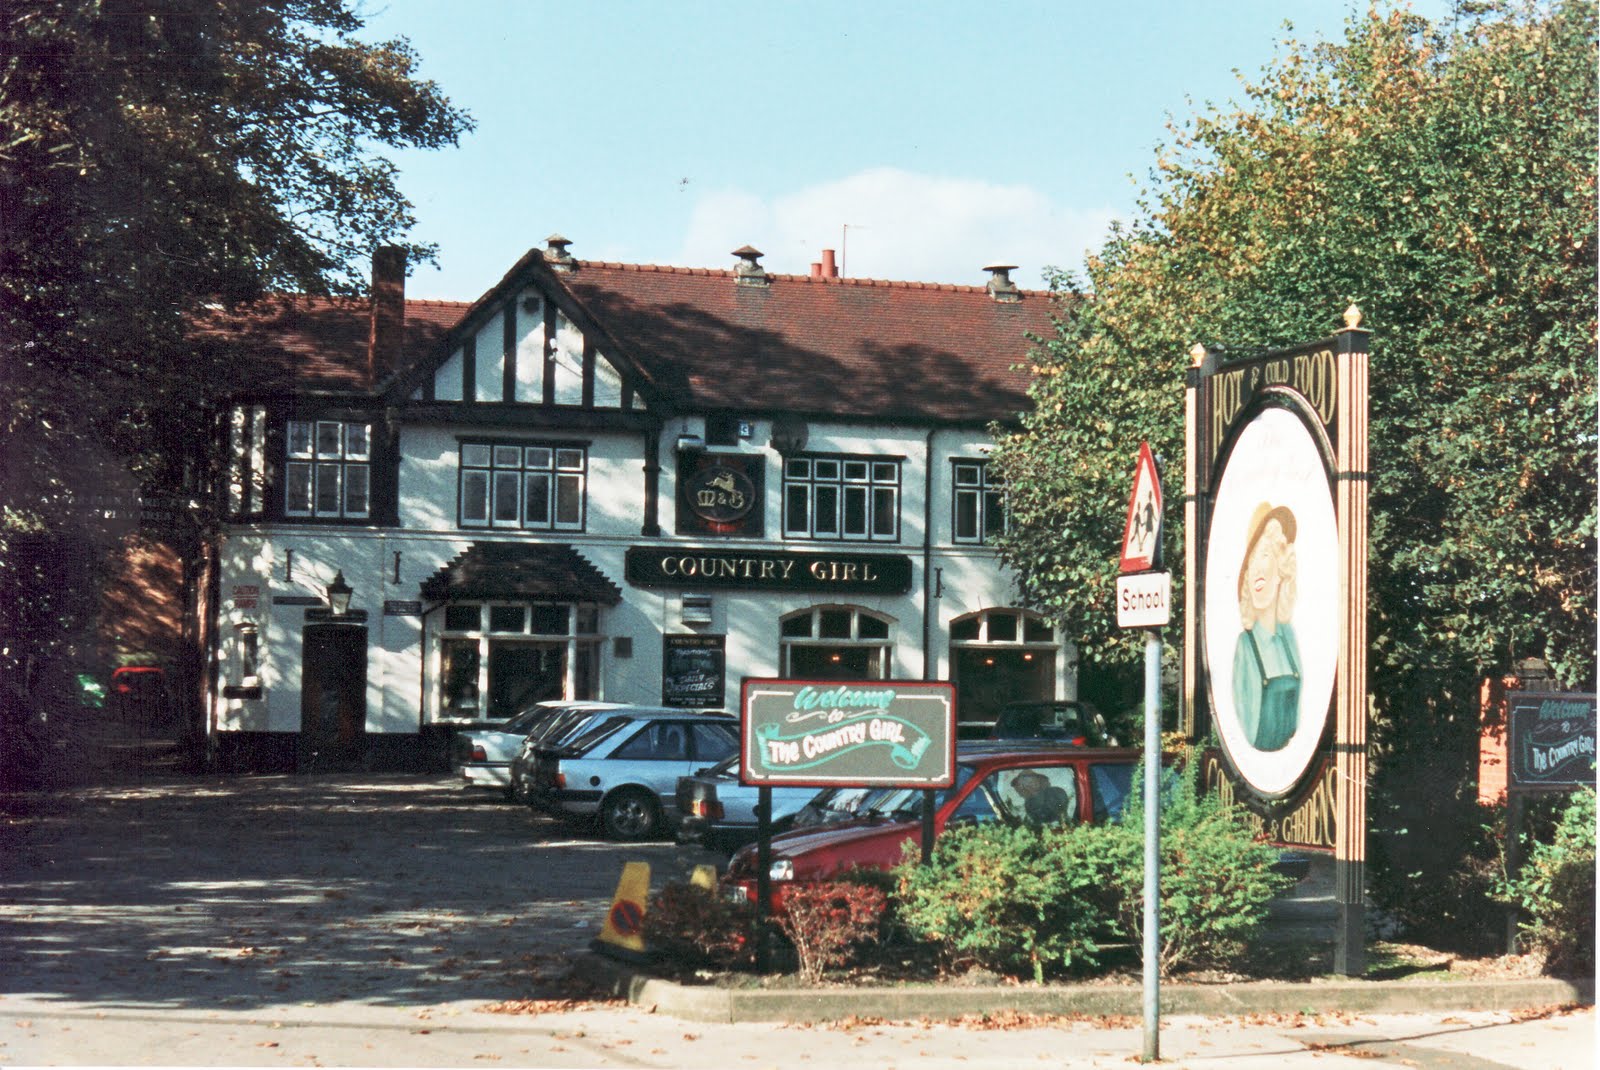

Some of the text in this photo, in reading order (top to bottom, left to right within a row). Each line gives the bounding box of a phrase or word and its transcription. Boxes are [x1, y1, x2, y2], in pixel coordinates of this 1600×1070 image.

[1213, 368, 1245, 462] HOT
[1251, 366, 1260, 391] &
[1265, 360, 1289, 385] COLD
[1294, 350, 1337, 425] FOOD
[662, 556, 877, 582] COUNTRY GIRL
[1122, 585, 1164, 611] School
[794, 685, 896, 710] Welcome
[828, 709, 844, 723] to
[1283, 767, 1337, 847] GARDENS
